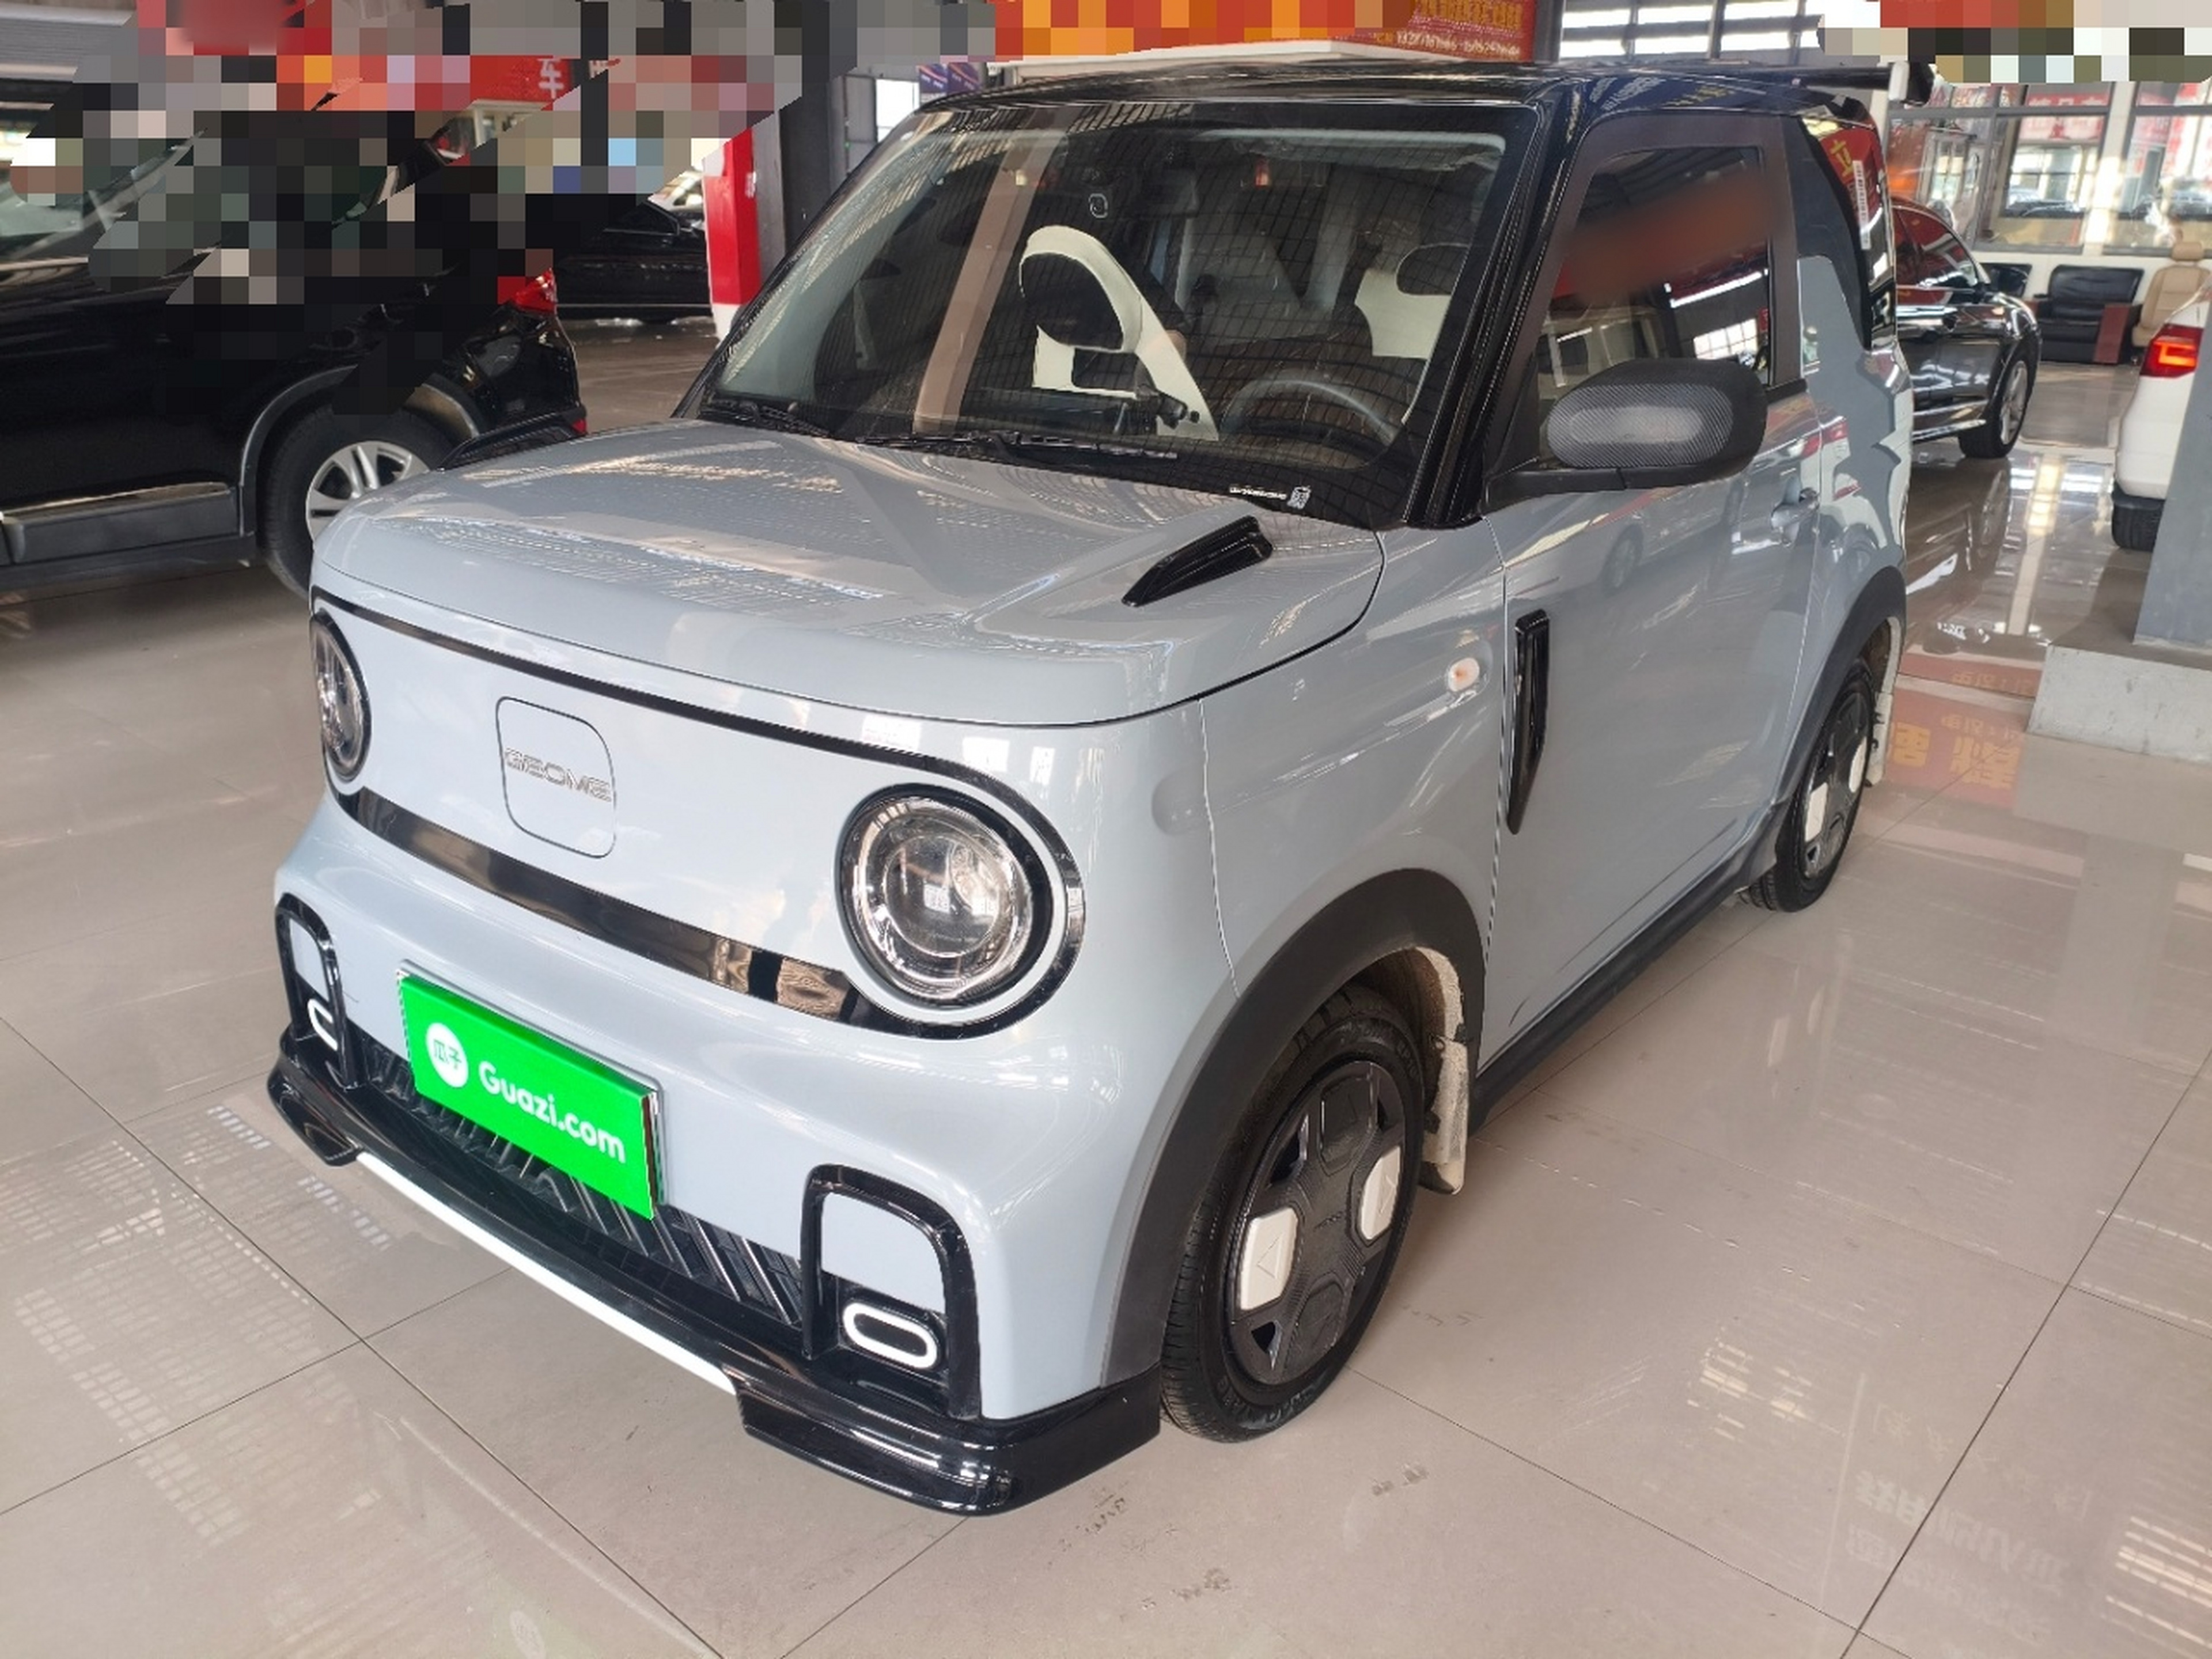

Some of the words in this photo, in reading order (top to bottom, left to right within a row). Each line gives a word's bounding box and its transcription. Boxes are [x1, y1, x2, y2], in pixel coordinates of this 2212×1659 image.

[505, 748, 611, 802] GEOME
[433, 1038, 462, 1070] 瓜子
[479, 1060, 626, 1164] Guazi.com
